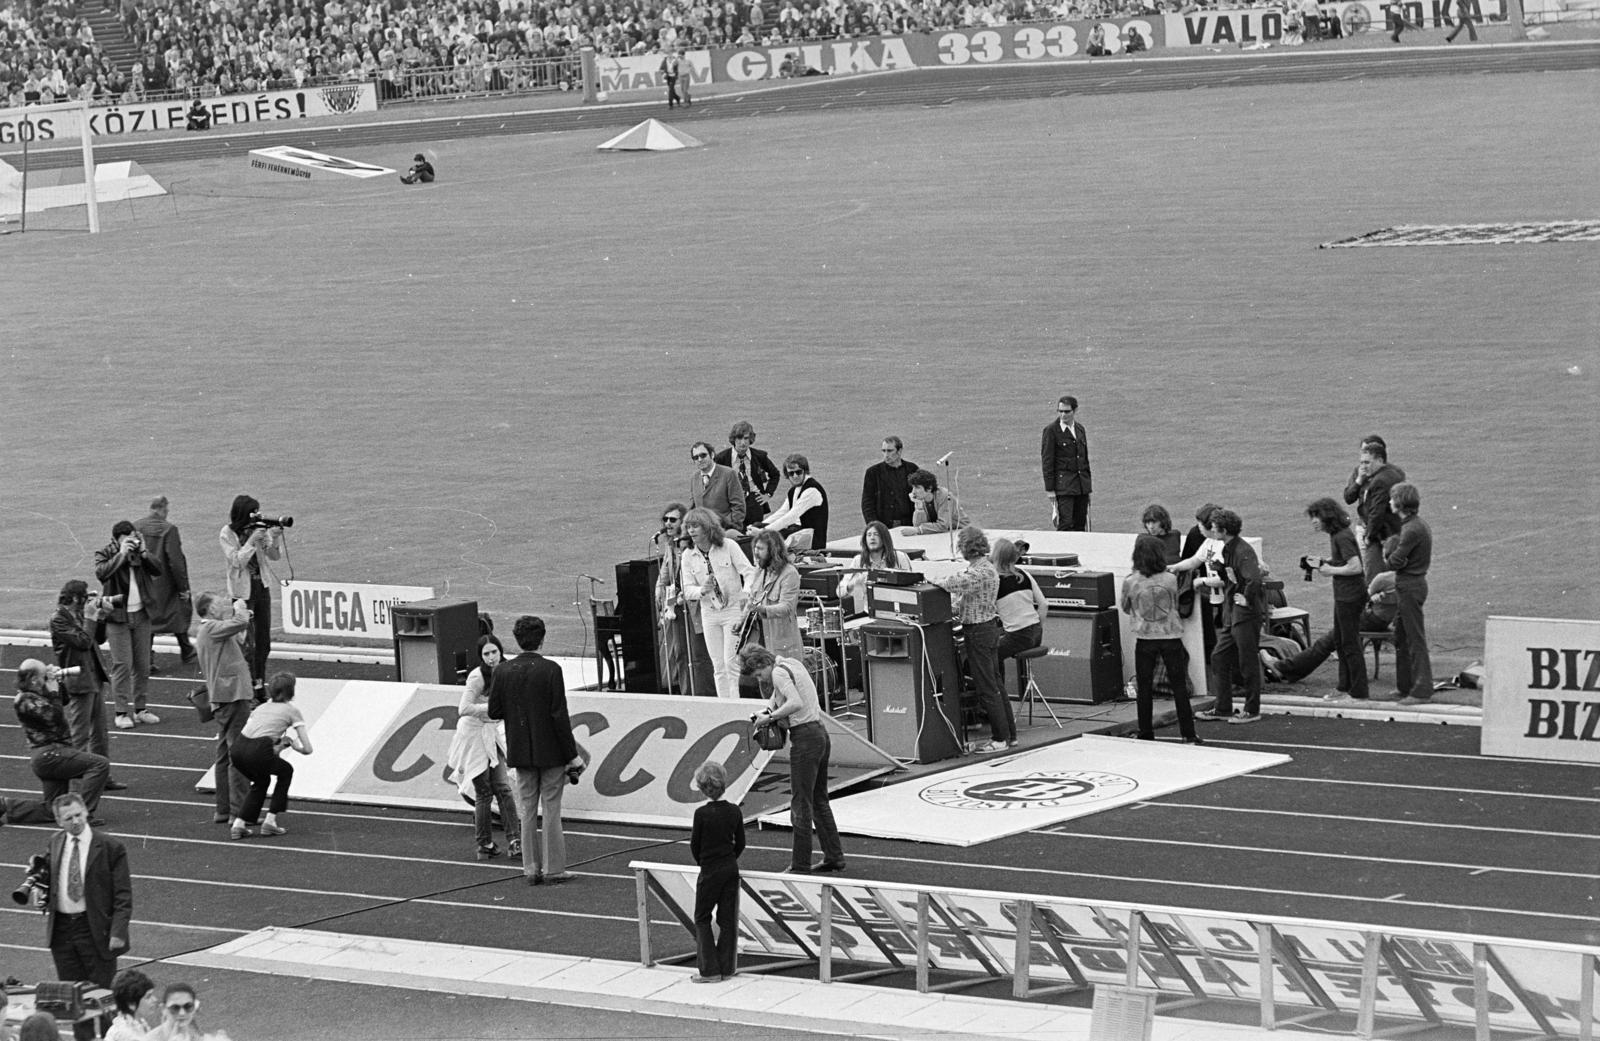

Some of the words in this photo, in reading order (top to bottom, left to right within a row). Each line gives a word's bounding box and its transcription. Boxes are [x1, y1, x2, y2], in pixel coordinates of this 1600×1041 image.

[1380, 0, 1525, 31] TOKAJ
[937, 31, 1003, 65] 33
[1013, 25, 1079, 60] 33
[601, 66, 710, 92] MALV
[89, 92, 307, 136] KÖZLEEDÉS!
[290, 589, 368, 633] OMEGA
[372, 705, 762, 804] CSCO
